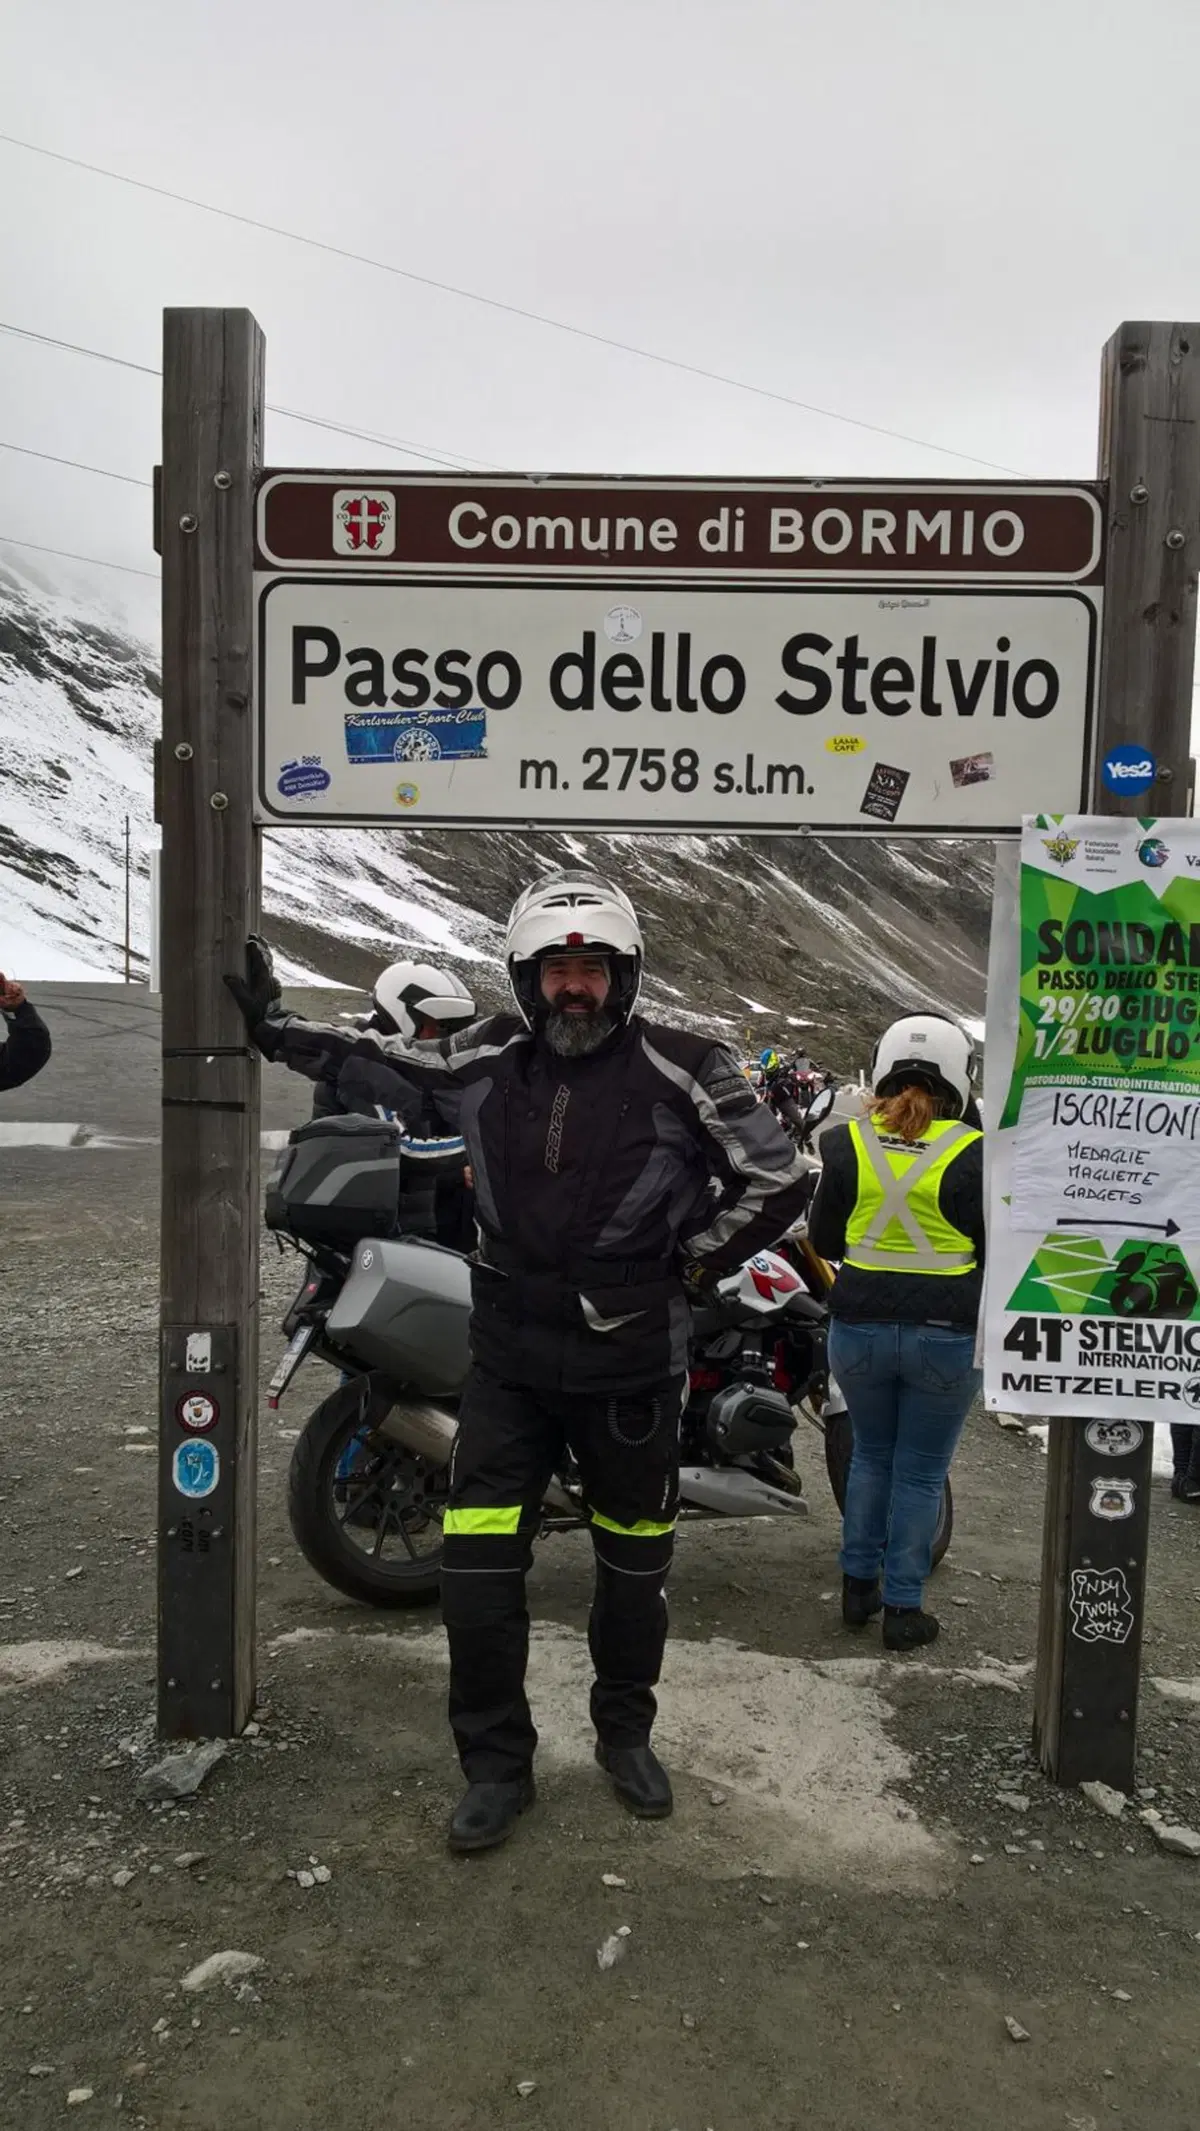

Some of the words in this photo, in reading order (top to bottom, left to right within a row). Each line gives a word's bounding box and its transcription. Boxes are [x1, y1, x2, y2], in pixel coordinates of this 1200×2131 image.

[448, 501, 677, 551] Comune
[698, 507, 744, 552] di
[769, 507, 1025, 556] BORMIO
[291, 624, 522, 710] Passo
[549, 630, 747, 716] dello
[775, 632, 1060, 718] Stelvio
[519, 758, 570, 791] m.
[582, 747, 699, 793] 2758
[713, 753, 815, 795] s.l.m.
[1106, 760, 1153, 778] Yes2
[1037, 970, 1099, 990] PASSO
[1105, 970, 1158, 991] DELLO
[1164, 971, 1200, 992] STE
[1067, 1140, 1151, 1165] MEDAGLIE
[1068, 1164, 1160, 1186] MAGLIETTE
[1063, 1184, 1143, 1205] GADGETS
[1002, 1372, 1182, 1401] METZELER
[1083, 1617, 1125, 1638] 2017
